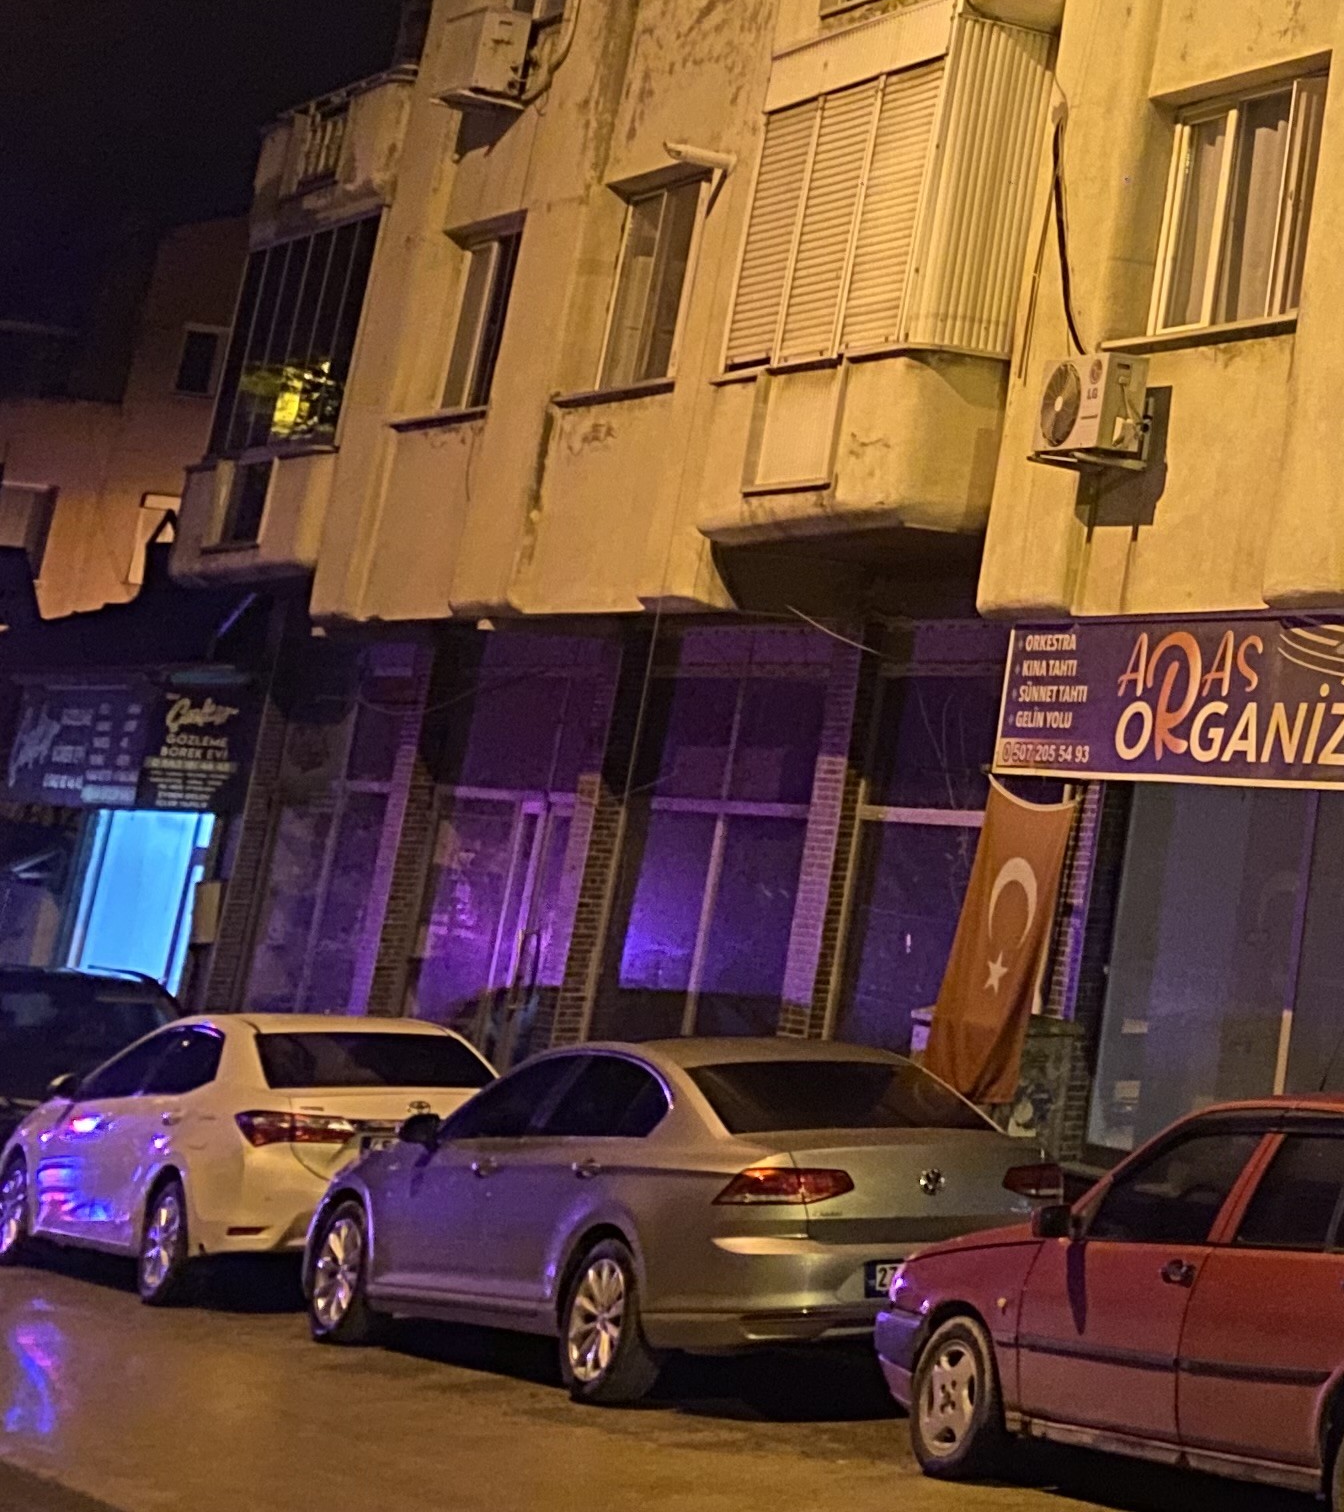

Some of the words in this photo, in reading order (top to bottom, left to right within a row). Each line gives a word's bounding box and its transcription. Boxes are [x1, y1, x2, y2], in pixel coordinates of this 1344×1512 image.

[1086, 388, 1098, 400] LG
[1025, 634, 1077, 651] ORKESTRA
[1021, 660, 1047, 677] KINA
[1049, 659, 1077, 676] TAHTI
[1117, 629, 1263, 728] ARAS
[1018, 681, 1058, 703] SÜNNET
[1057, 685, 1088, 703] TAHTI
[1015, 706, 1046, 728] GELİN
[1046, 711, 1073, 729] YOLU
[1034, 744, 1056, 762] 205
[1058, 744, 1073, 763] 54
[1075, 745, 1090, 763] 93
